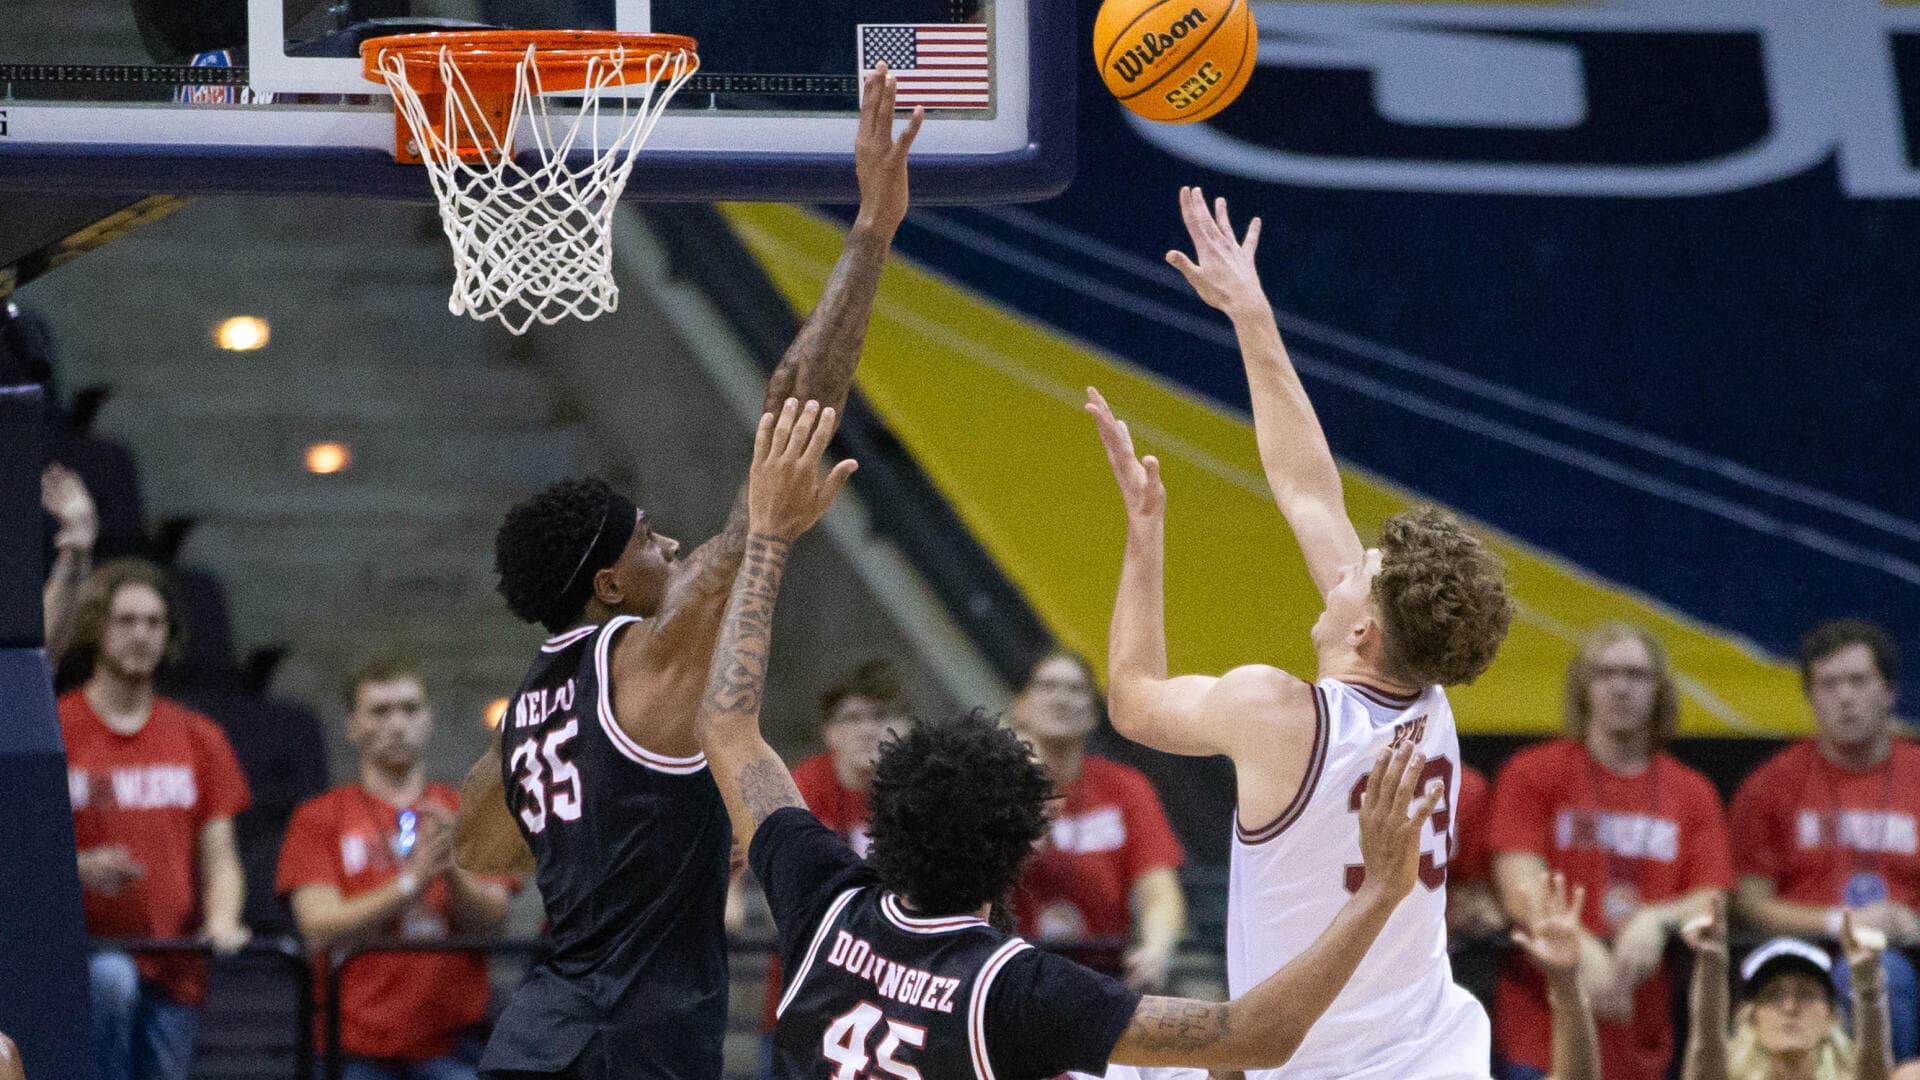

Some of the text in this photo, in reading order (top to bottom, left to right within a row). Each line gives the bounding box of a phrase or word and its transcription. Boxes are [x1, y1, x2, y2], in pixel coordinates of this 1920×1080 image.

[1112, 8, 1208, 82] Wilson
[1165, 61, 1222, 109] SBC
[510, 716, 581, 833] 35
[823, 1000, 928, 1080] 45
